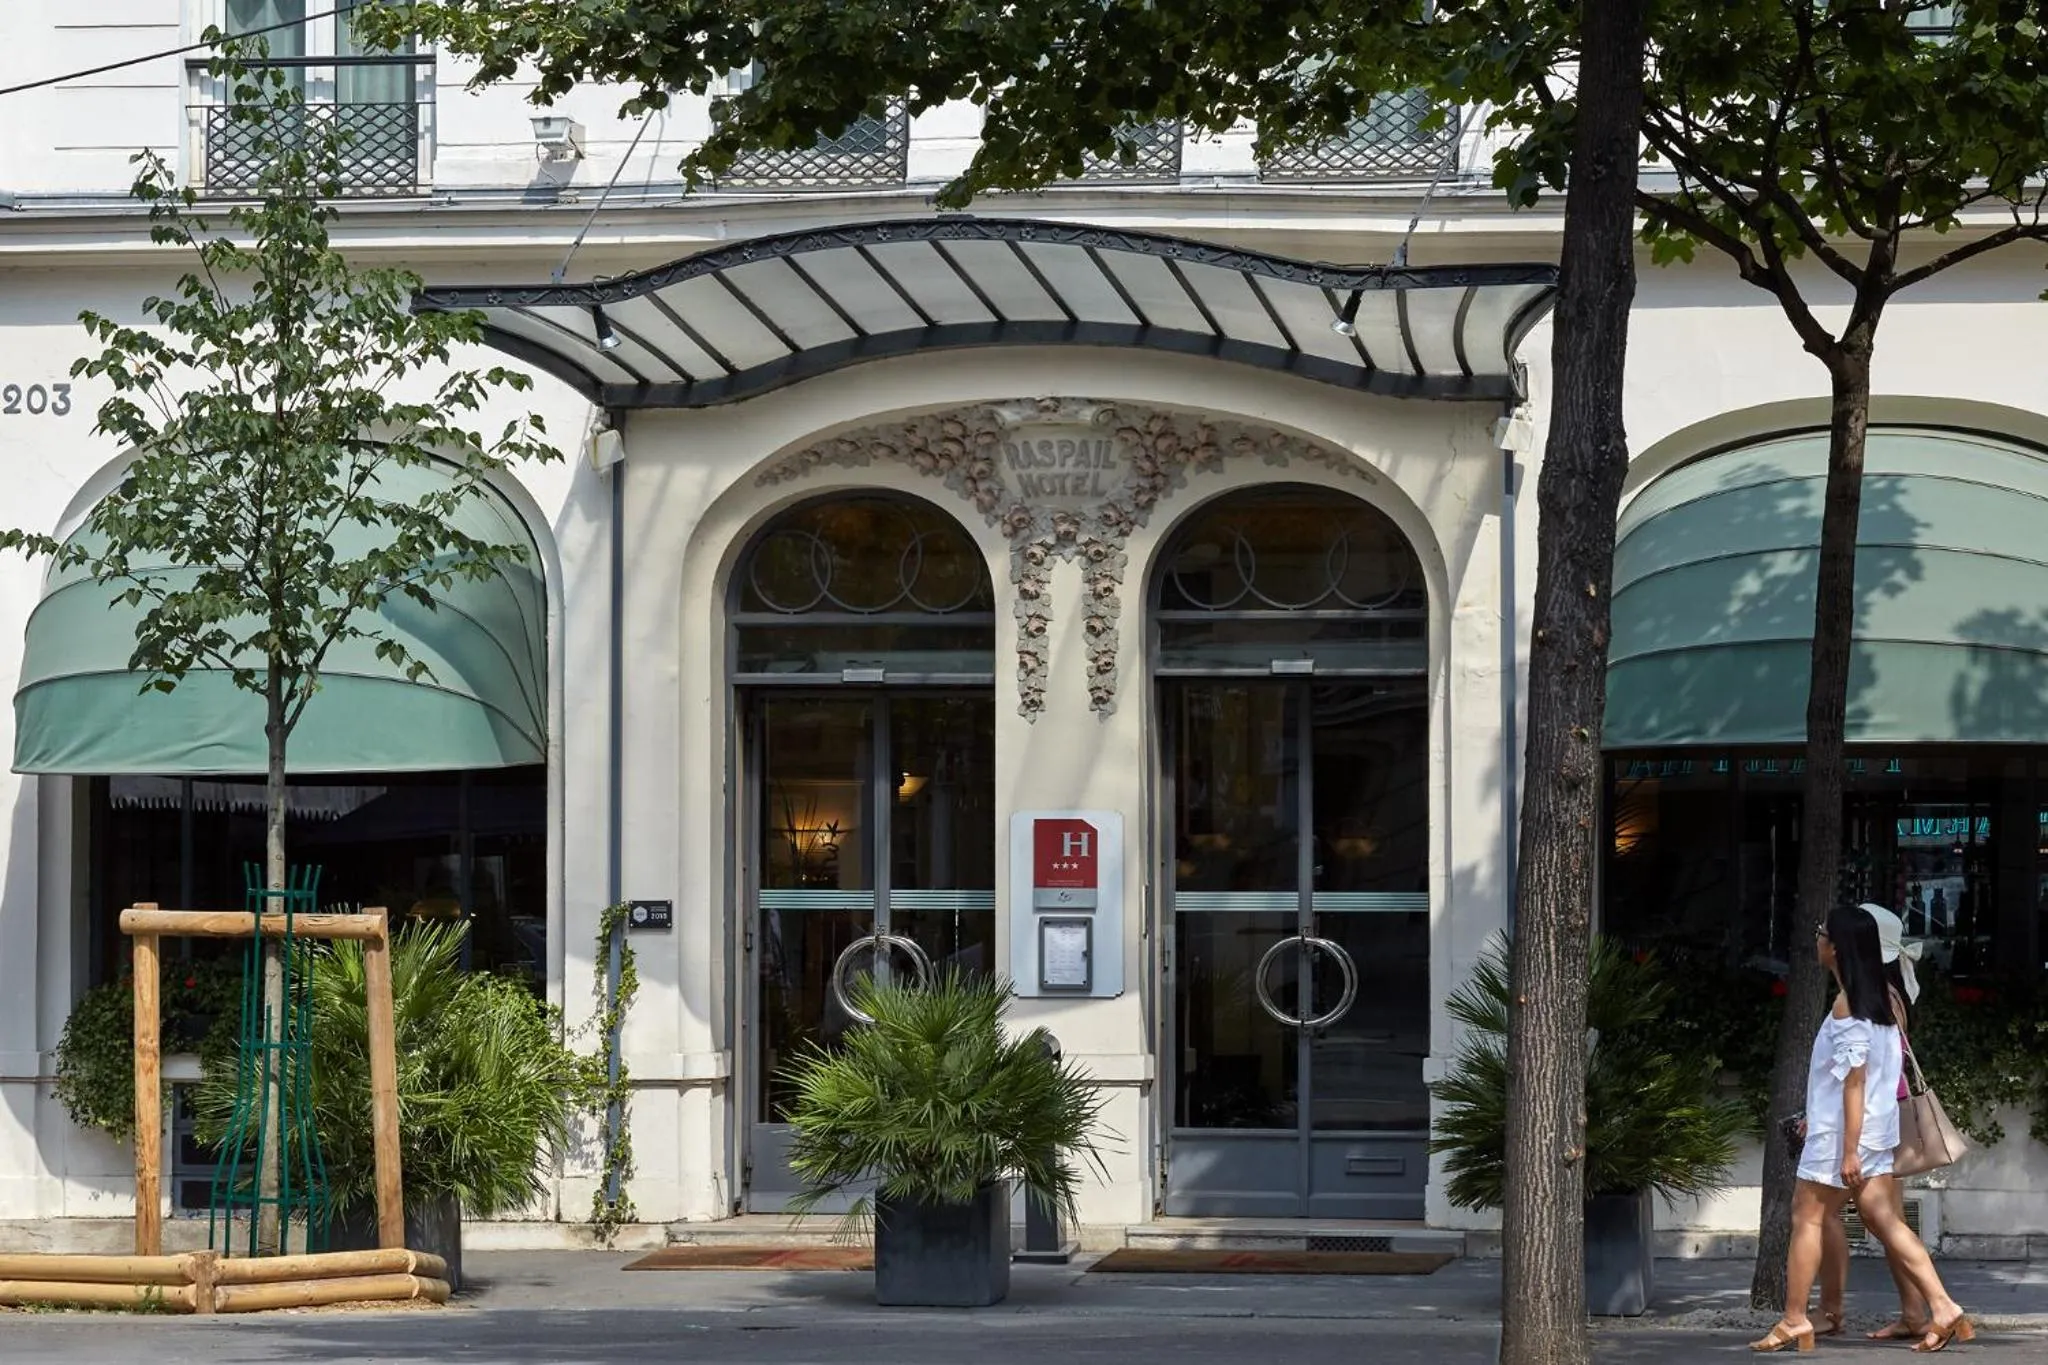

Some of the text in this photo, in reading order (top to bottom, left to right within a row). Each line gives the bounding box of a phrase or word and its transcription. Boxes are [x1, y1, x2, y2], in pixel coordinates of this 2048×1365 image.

[3, 383, 72, 417] 203
[1003, 439, 1118, 470] RASPAIL
[1016, 472, 1108, 498] HOTEL
[1061, 832, 1091, 857] H
